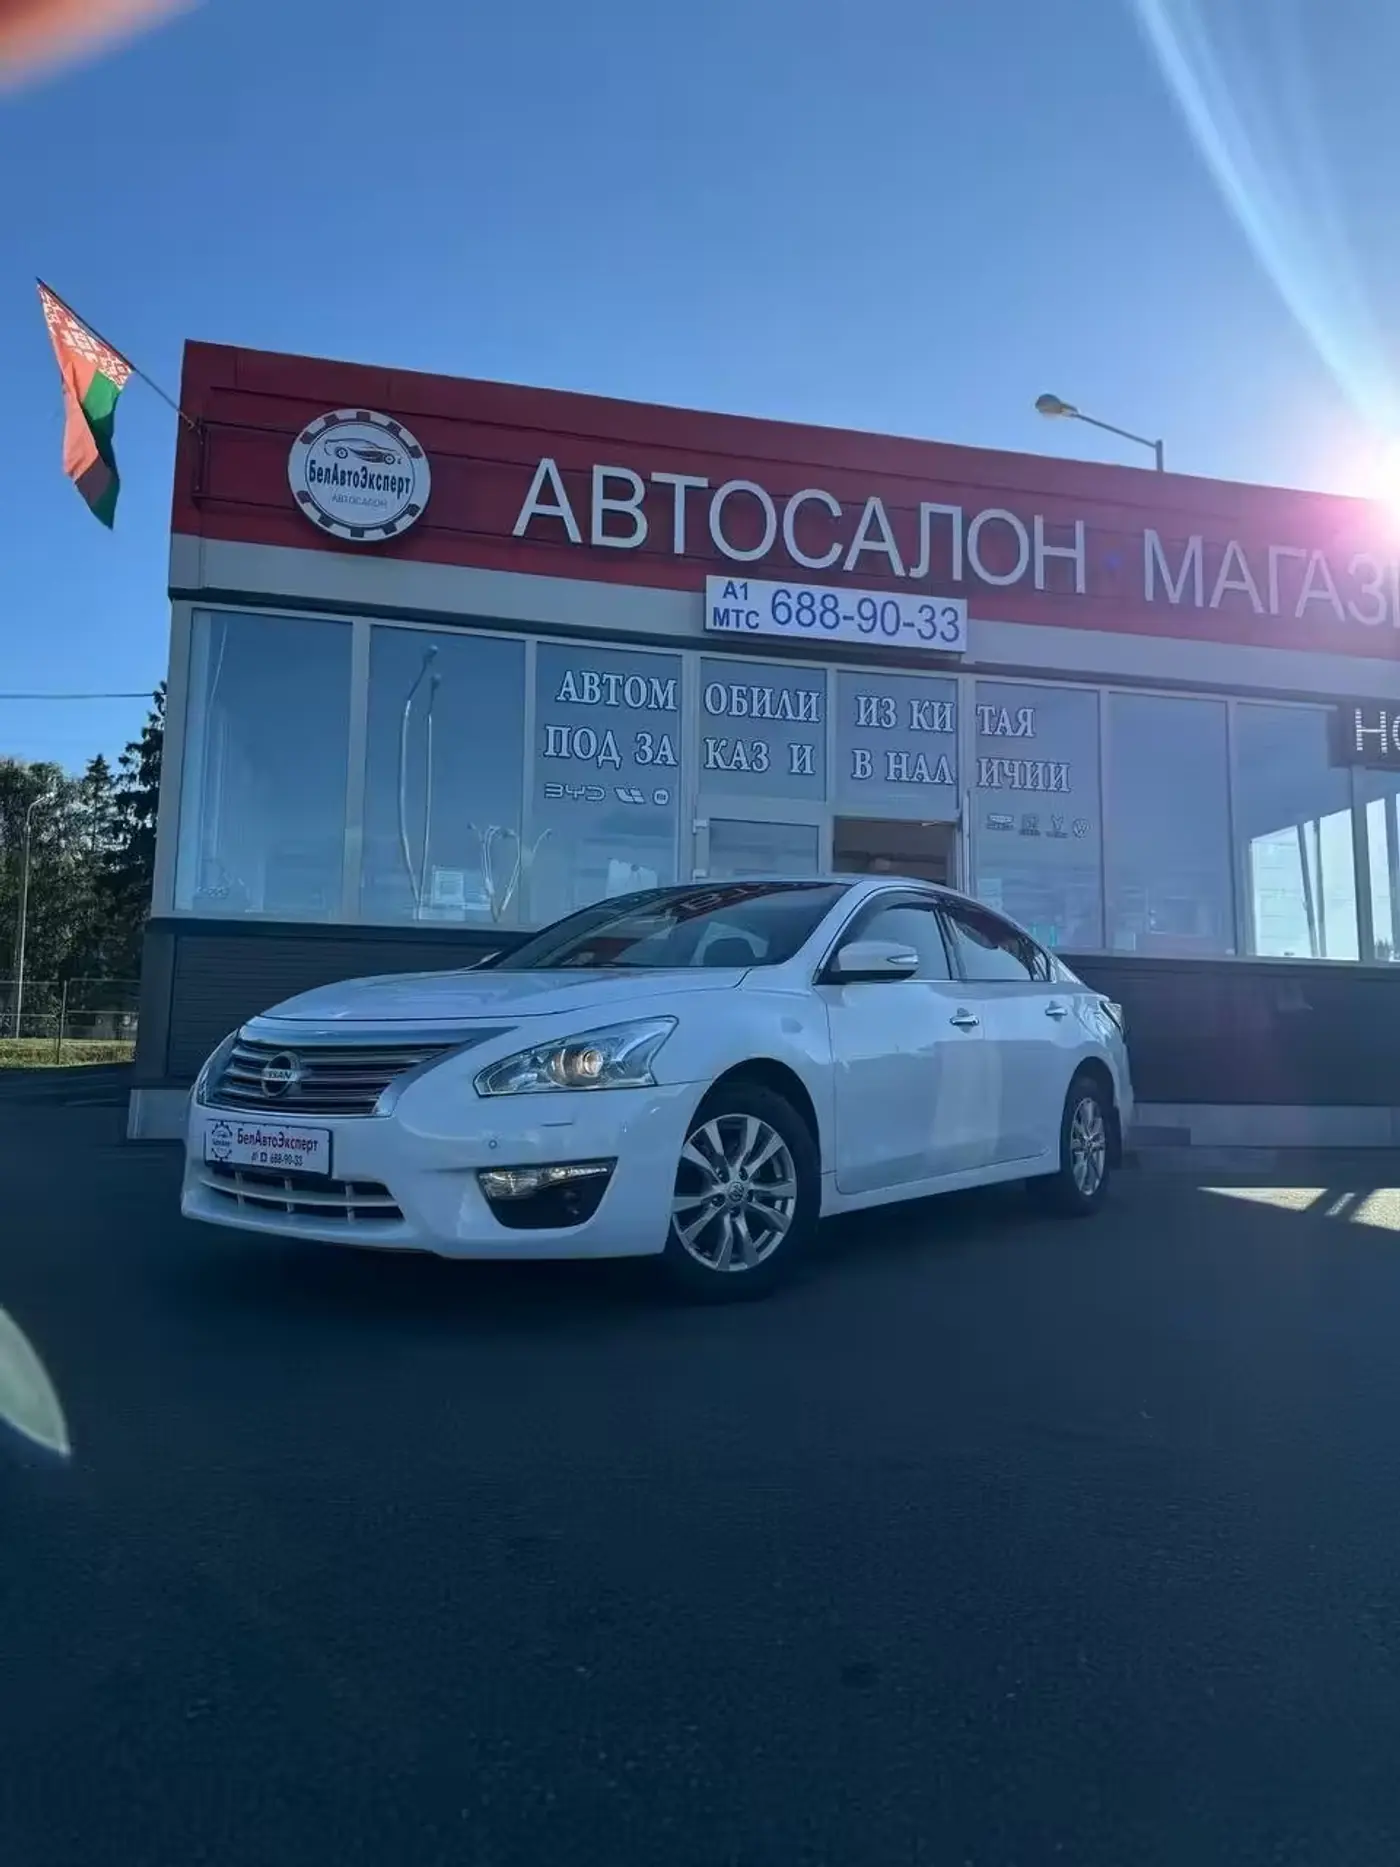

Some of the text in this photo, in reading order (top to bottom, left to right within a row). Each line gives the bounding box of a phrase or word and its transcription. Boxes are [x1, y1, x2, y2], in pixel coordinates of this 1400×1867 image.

[309, 459, 411, 499] БелАвтоЭксперт
[512, 457, 1400, 629] АВТОСАЛОН МАГАЗ
[713, 607, 760, 629] МТС
[771, 589, 960, 643] 688-90-33
[856, 695, 897, 728] ИЗ
[544, 724, 622, 770] ПОД
[789, 743, 816, 776] И
[852, 748, 873, 780] В
[544, 781, 606, 801] BYD
[237, 1127, 319, 1155] БелАвтоЭксперт
